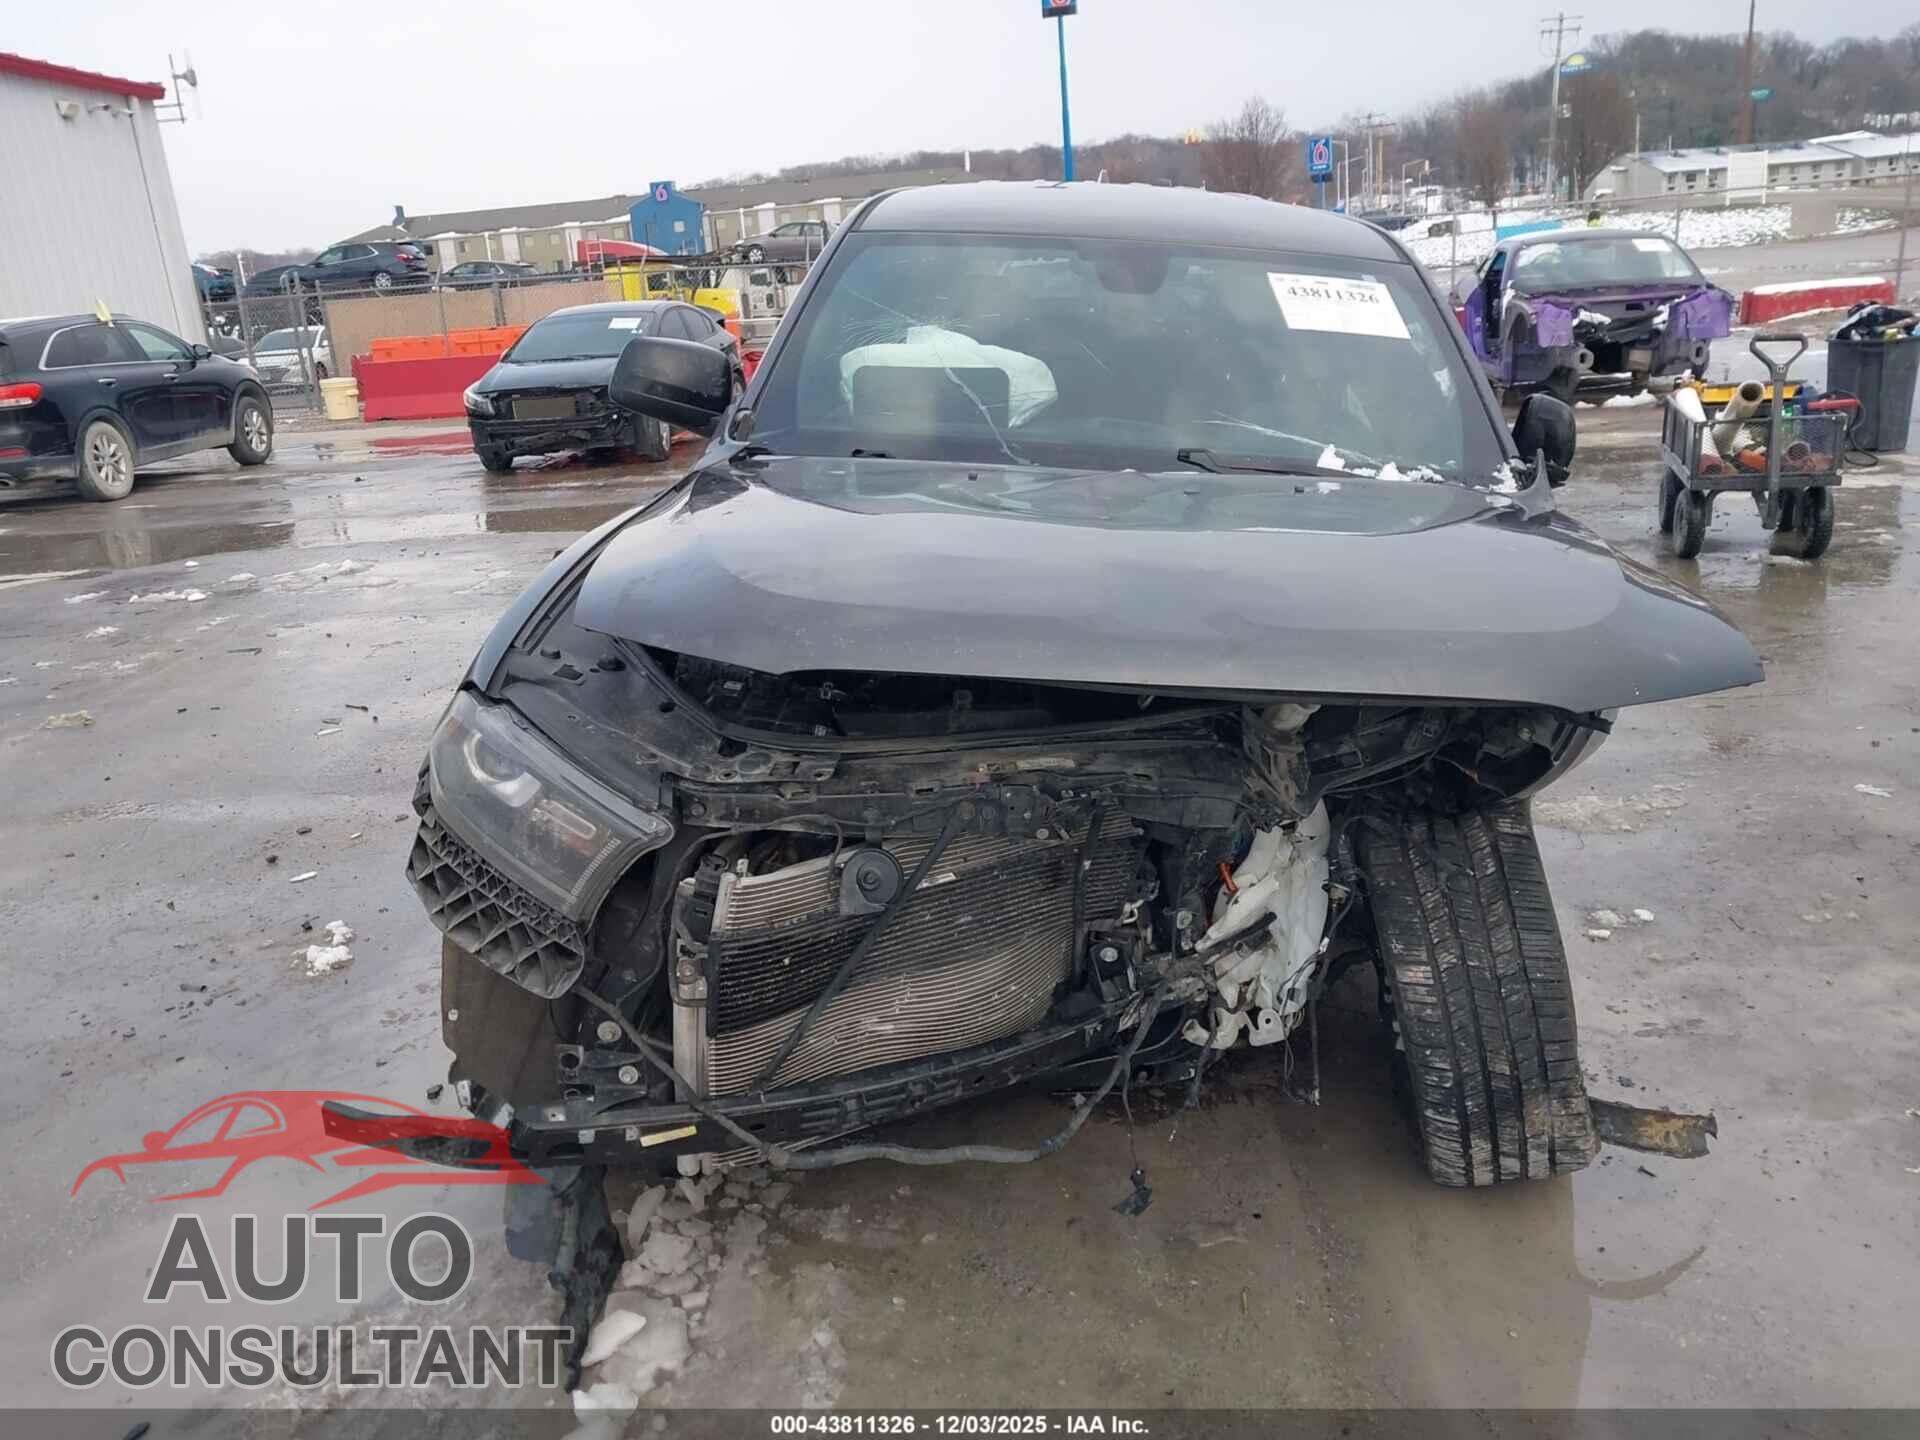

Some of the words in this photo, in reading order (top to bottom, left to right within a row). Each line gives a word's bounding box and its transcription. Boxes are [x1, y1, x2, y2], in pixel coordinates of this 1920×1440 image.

[1312, 138, 1329, 165] 6
[655, 183, 668, 202] 6
[1287, 285, 1380, 305] 43811326
